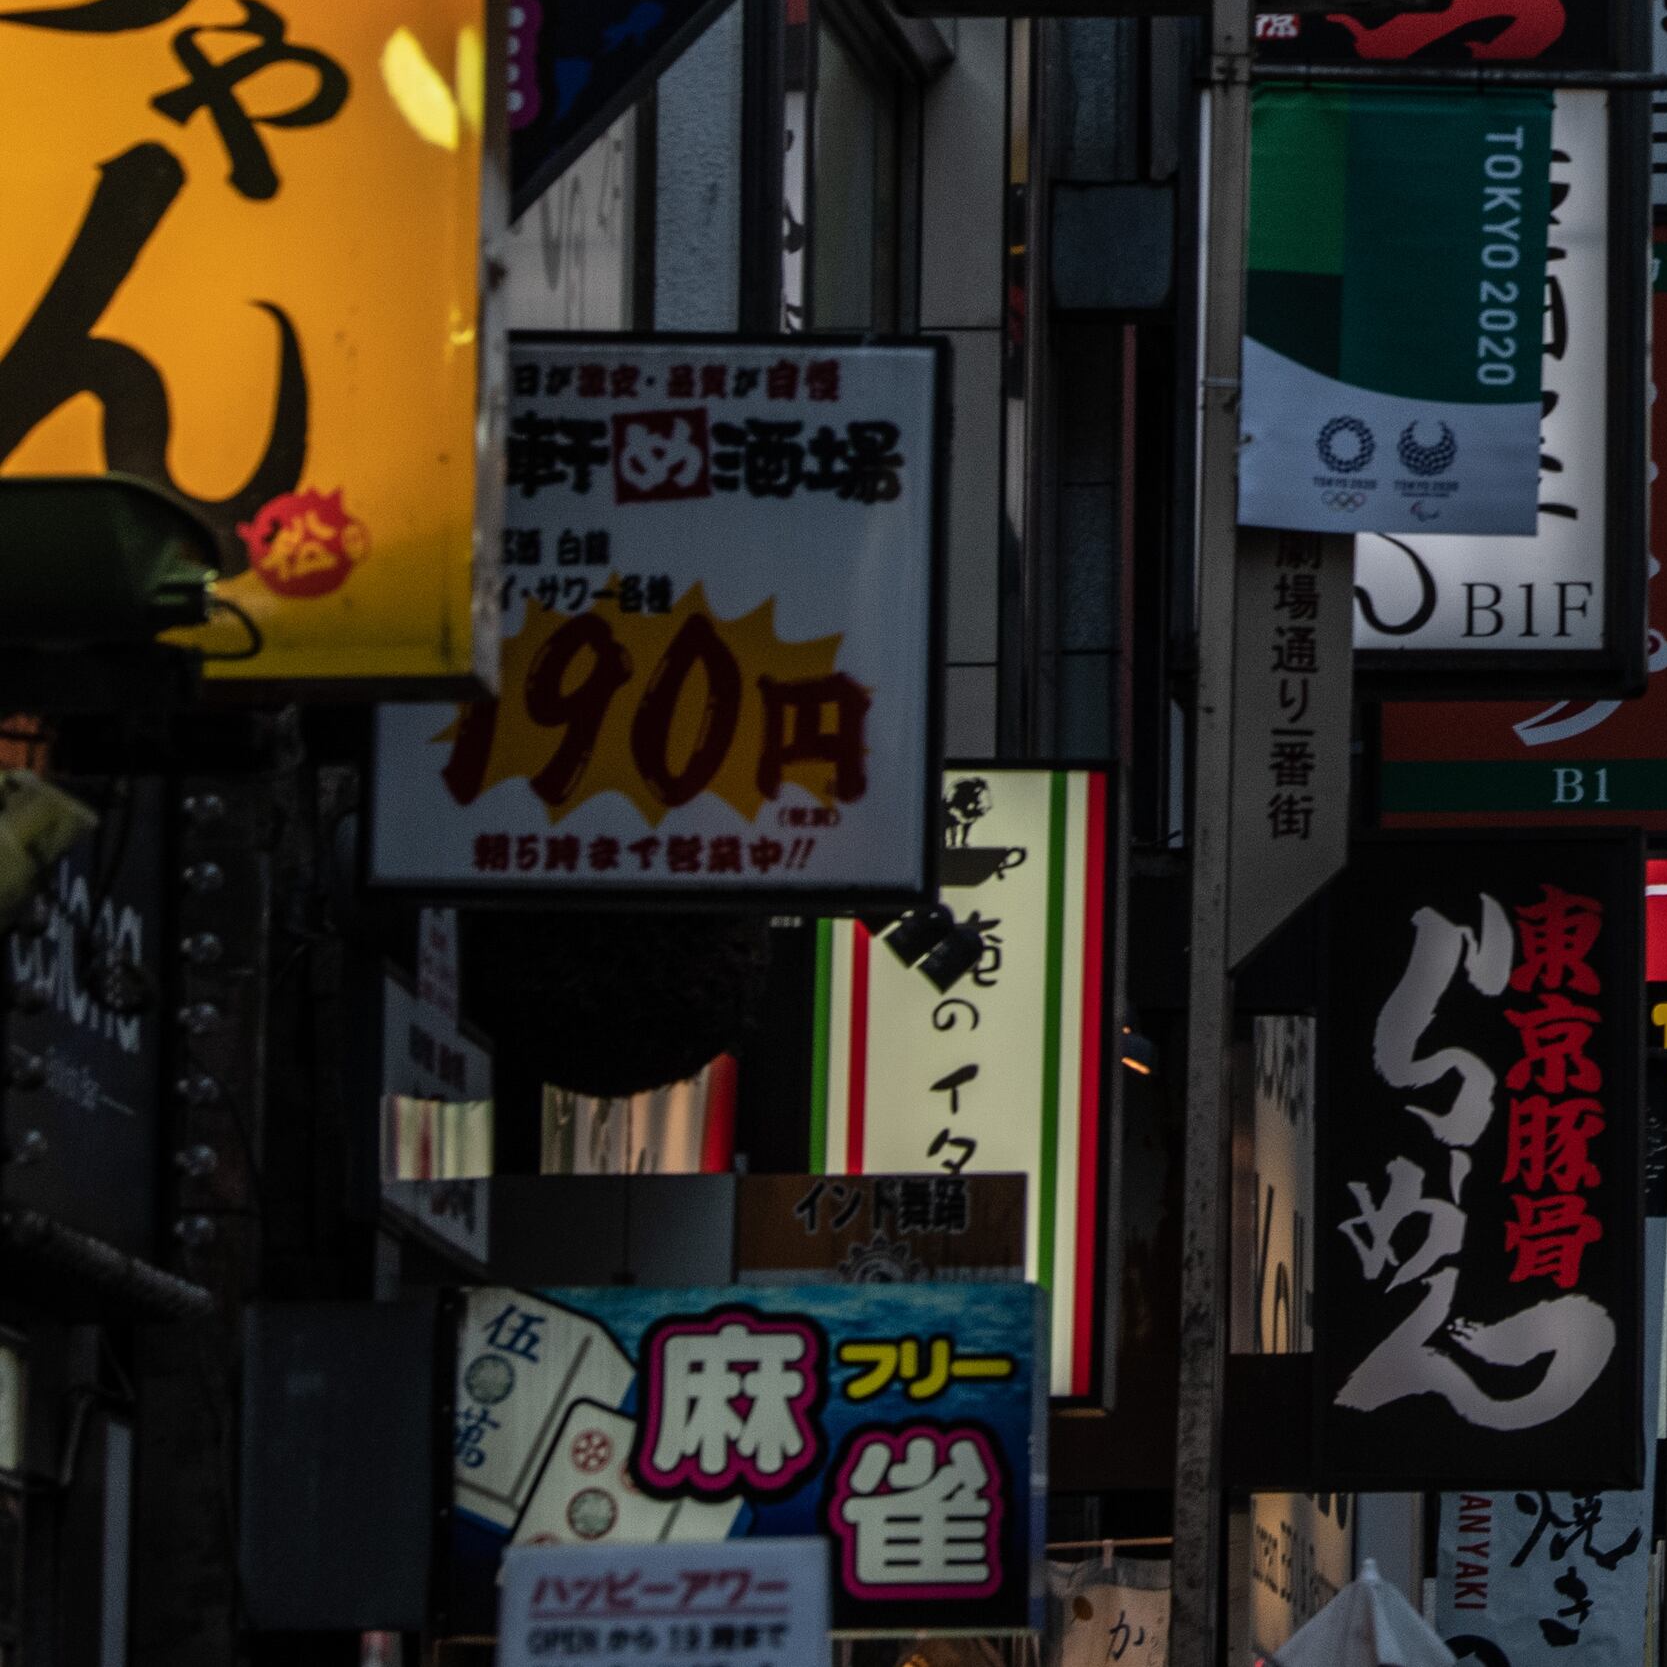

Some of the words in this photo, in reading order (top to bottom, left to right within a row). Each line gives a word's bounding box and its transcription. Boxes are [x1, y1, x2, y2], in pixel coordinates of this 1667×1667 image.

[1478, 125, 1525, 272] TOKYO
[1474, 278, 1522, 388] 2020
[1461, 580, 1595, 639] B1F
[1550, 767, 1613, 806] B1
[1501, 882, 1608, 1291] 東京豚骨
[839, 1338, 1014, 1399] フリー
